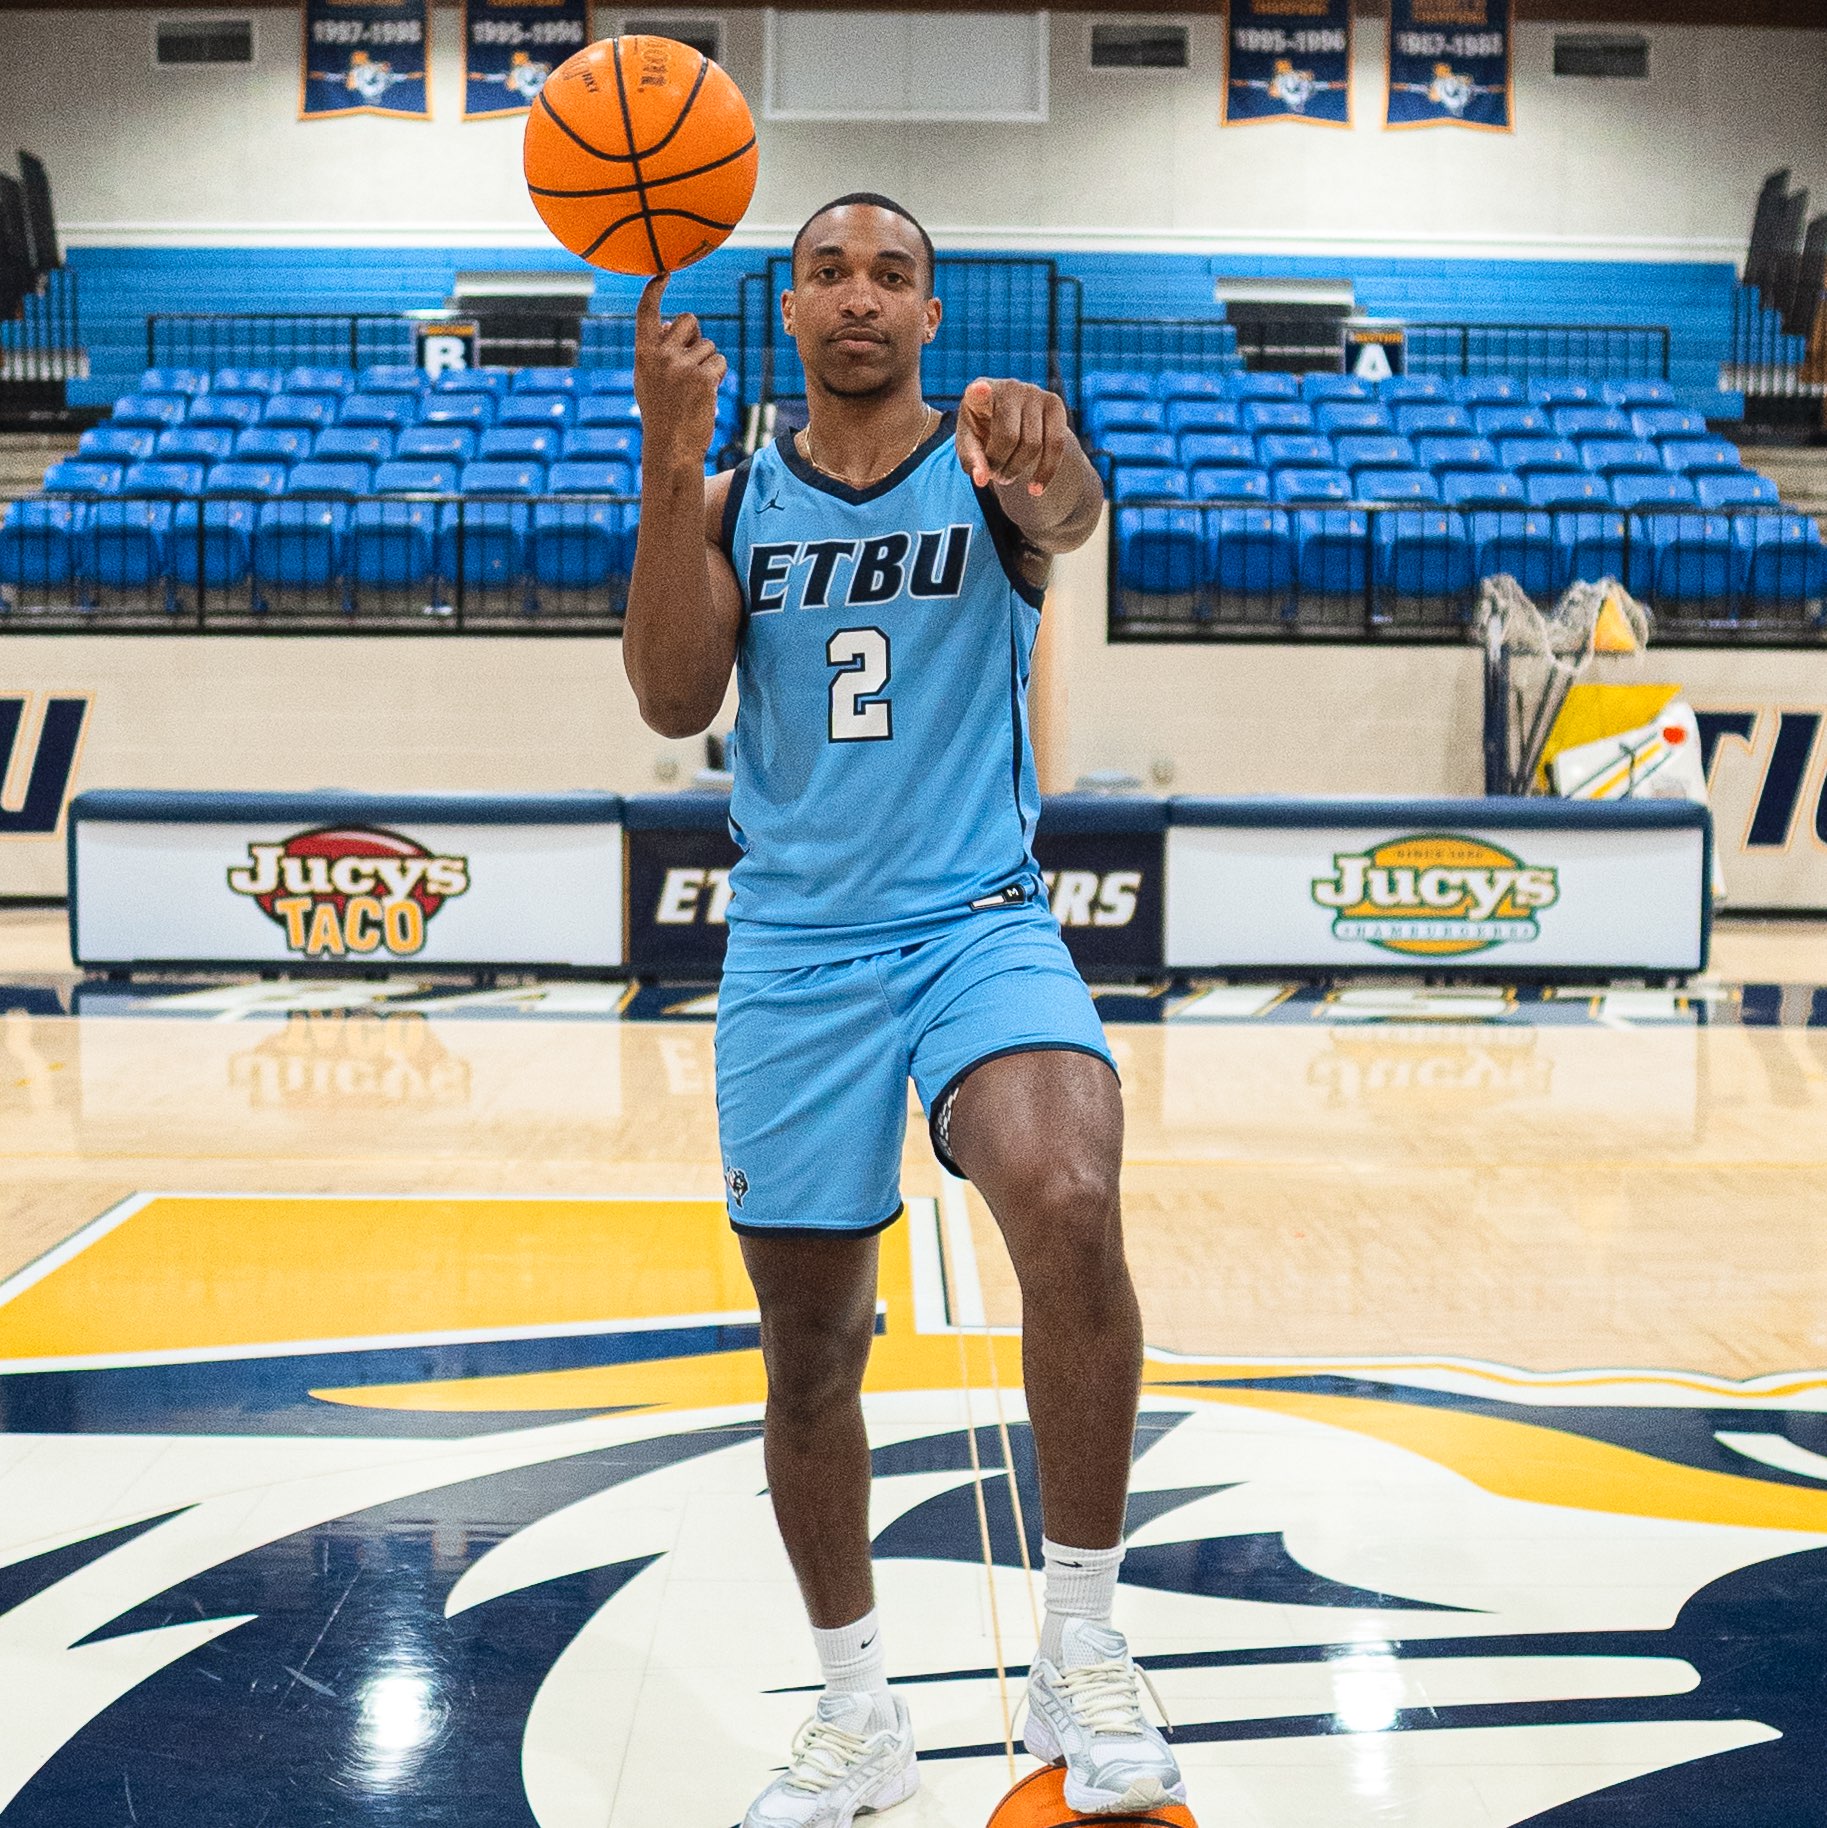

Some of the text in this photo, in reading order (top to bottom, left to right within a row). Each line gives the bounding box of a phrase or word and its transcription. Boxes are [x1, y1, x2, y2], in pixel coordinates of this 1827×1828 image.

[748, 523, 973, 617] ETBU
[825, 626, 894, 744] 2
[228, 843, 470, 906] Jucys
[1313, 855, 1558, 921] Jucys
[275, 896, 426, 954] TACO
